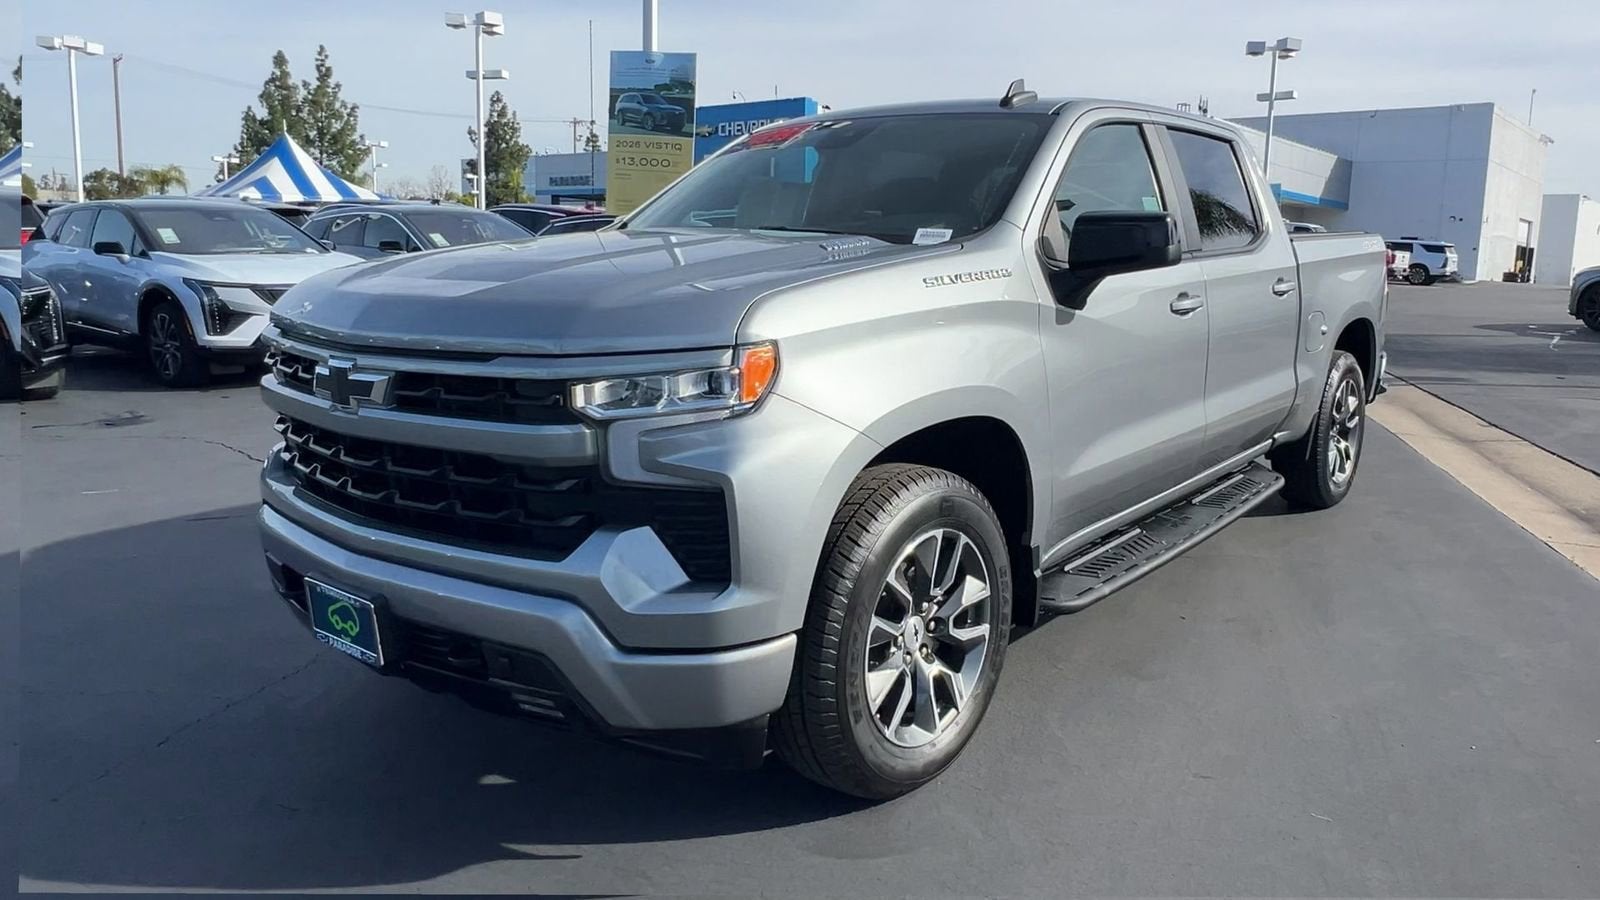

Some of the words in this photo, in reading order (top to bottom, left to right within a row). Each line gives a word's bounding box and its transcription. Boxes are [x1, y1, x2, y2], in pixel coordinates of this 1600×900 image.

[718, 120, 777, 136] CHEVRO
[615, 140, 641, 149] 2026
[644, 142, 683, 152] VISTIQ
[922, 268, 1013, 288] SILVERADO
